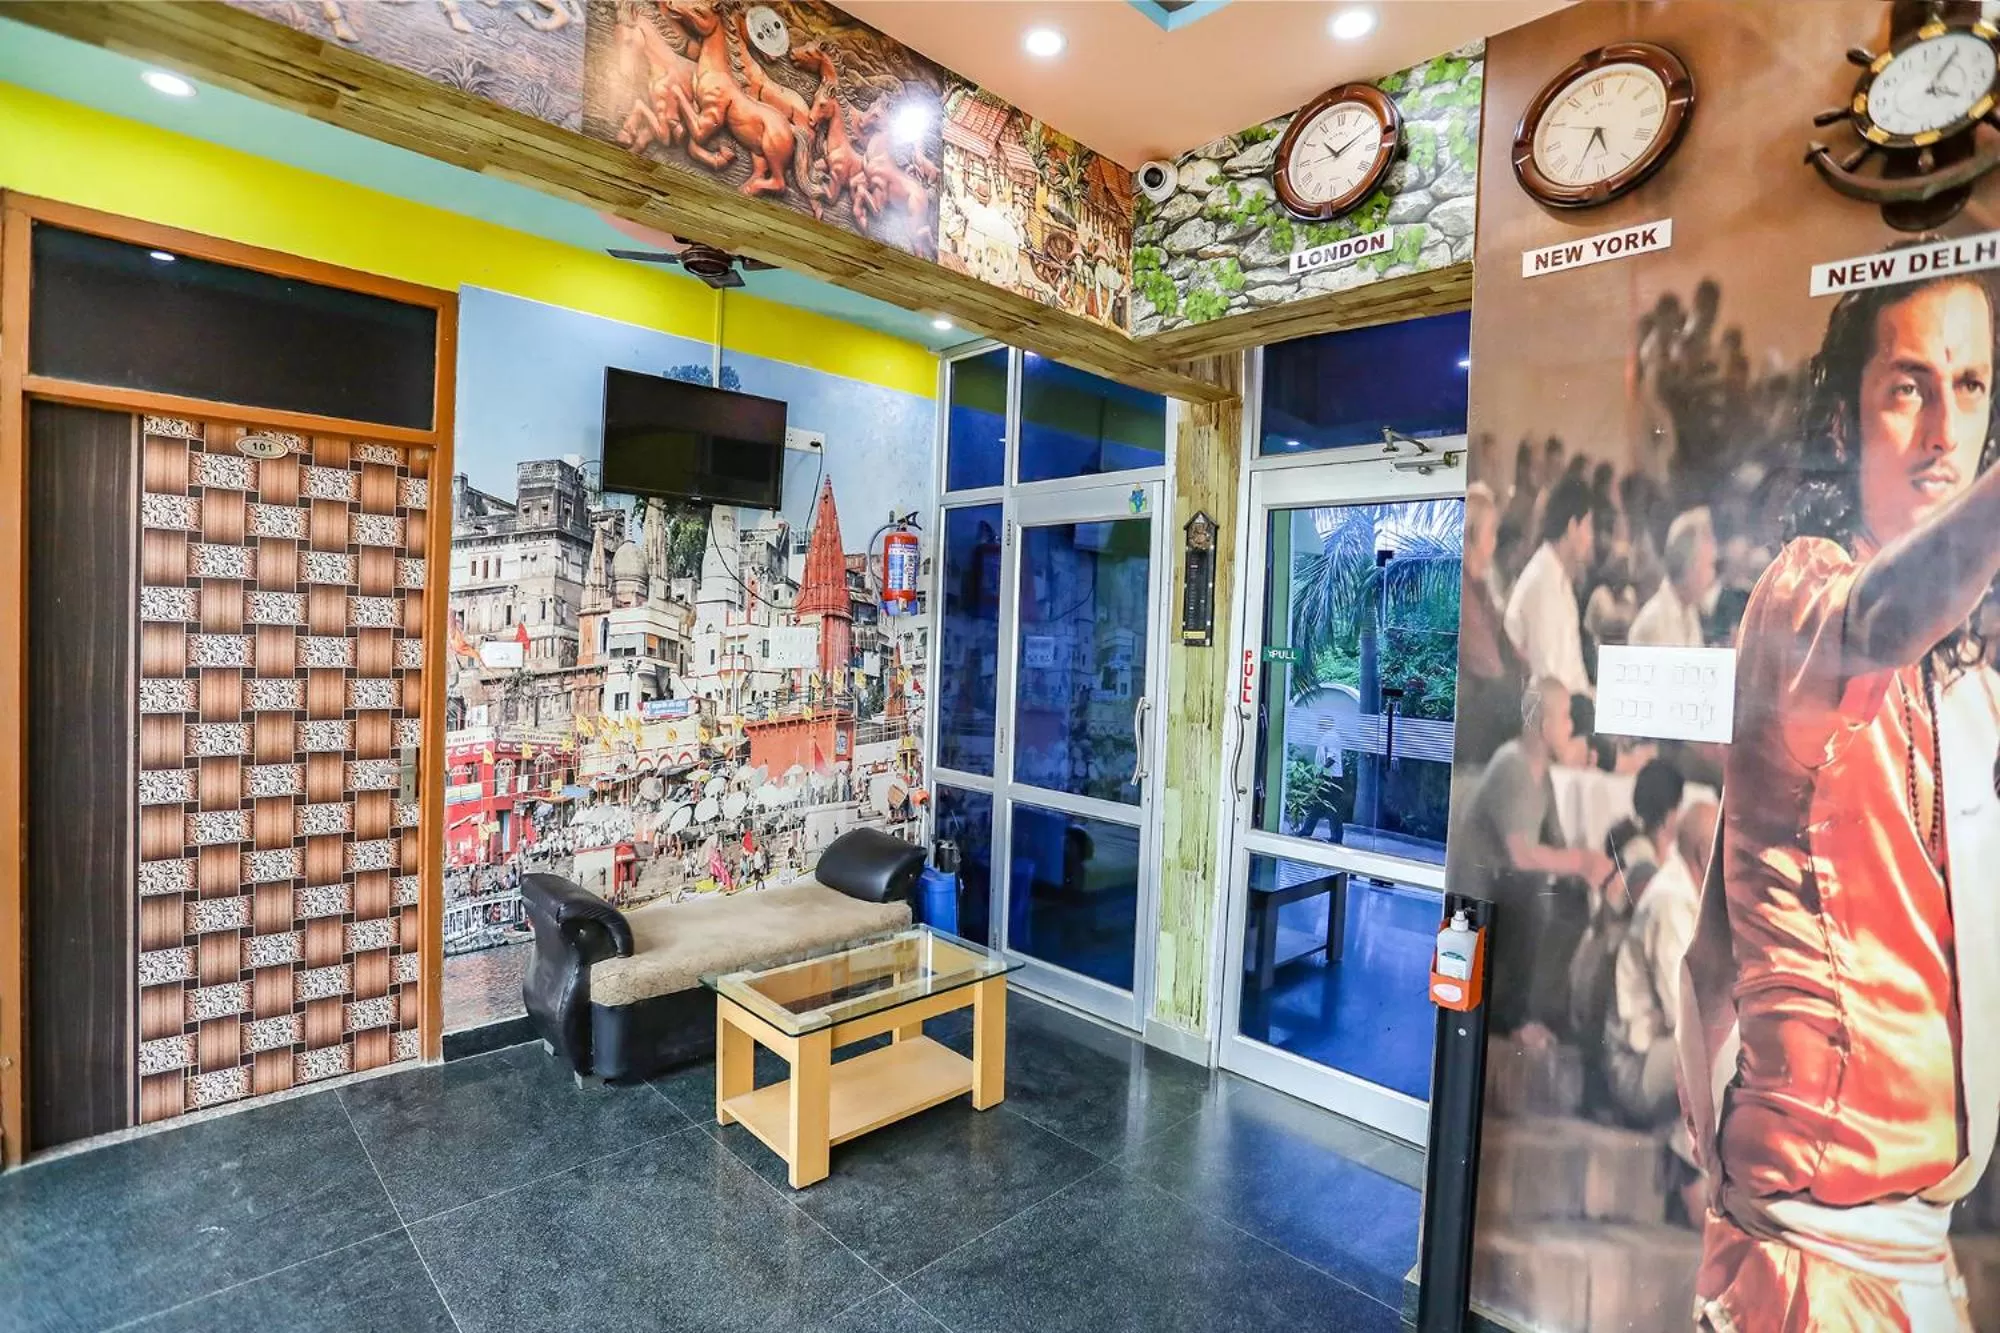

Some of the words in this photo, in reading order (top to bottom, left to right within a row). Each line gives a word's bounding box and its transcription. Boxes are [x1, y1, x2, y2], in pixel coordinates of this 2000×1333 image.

[1297, 233, 1385, 269] LONDON
[1535, 244, 1584, 271] NEW
[1592, 227, 1657, 257] YORK
[1828, 257, 1896, 288] NEW
[252, 442, 273, 452] 101
[1242, 649, 1254, 704] PULL
